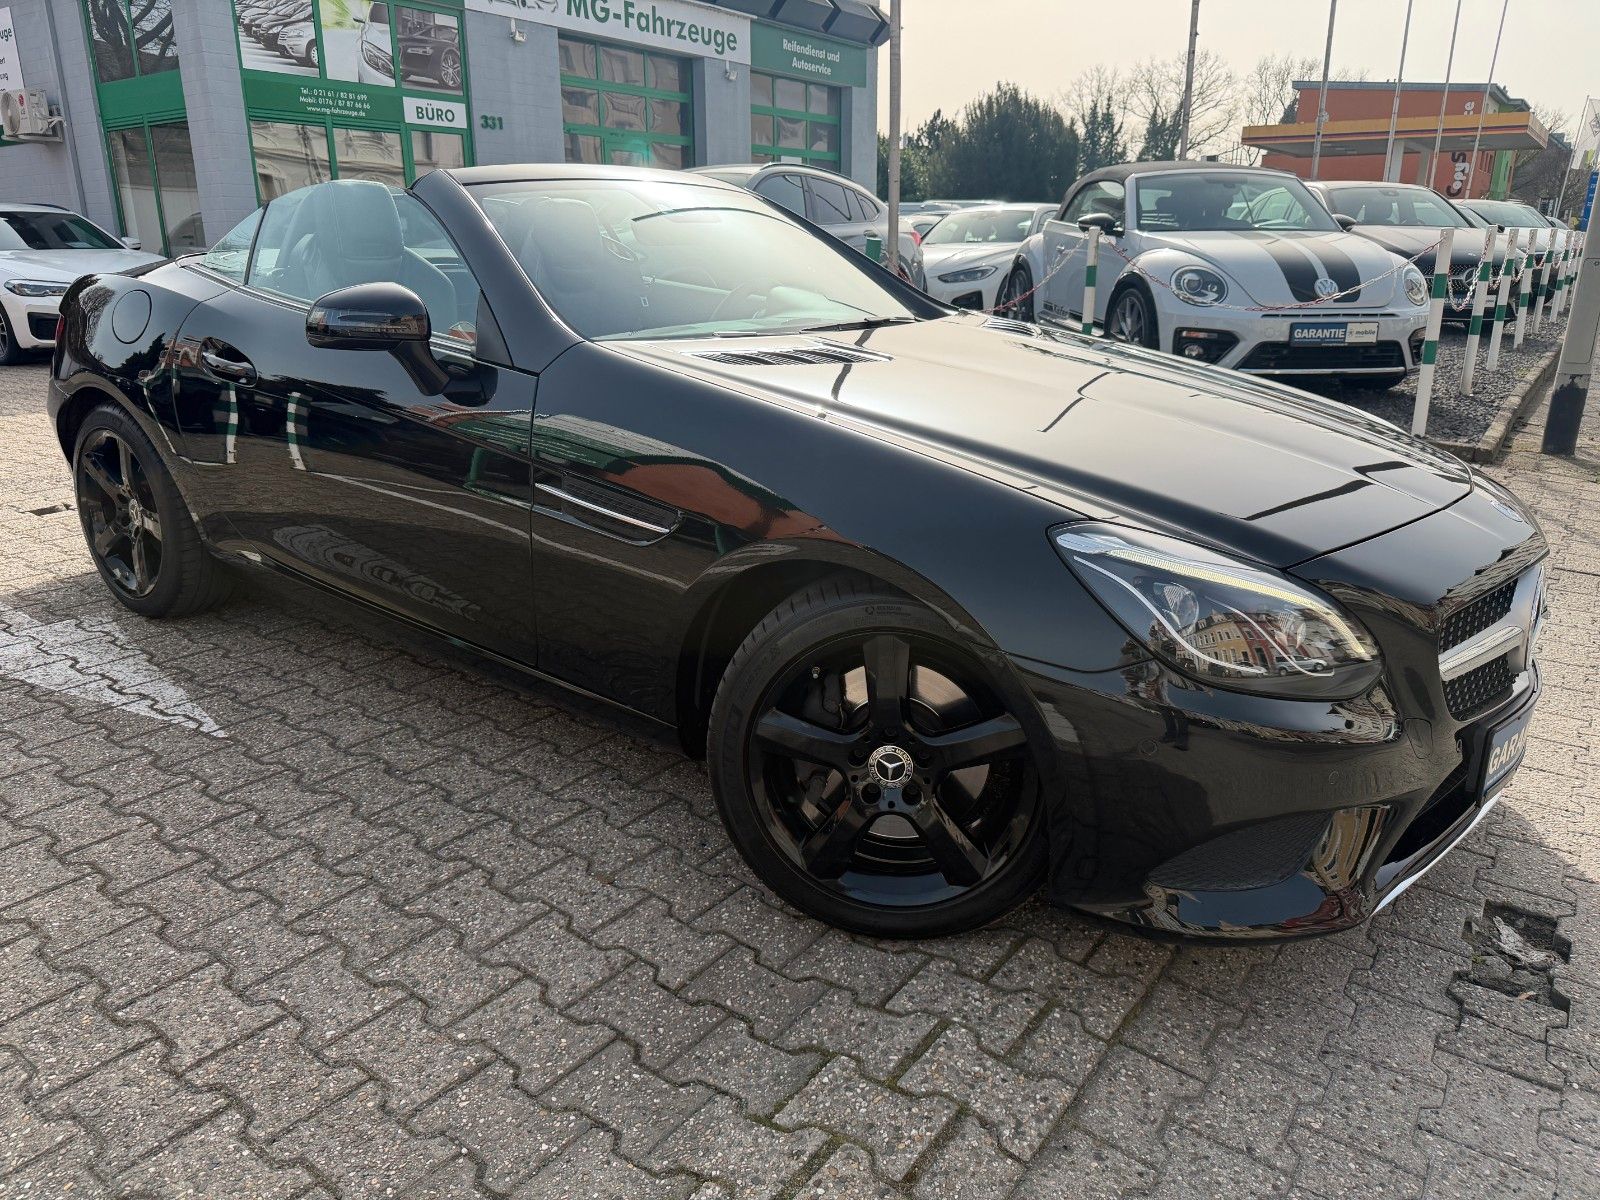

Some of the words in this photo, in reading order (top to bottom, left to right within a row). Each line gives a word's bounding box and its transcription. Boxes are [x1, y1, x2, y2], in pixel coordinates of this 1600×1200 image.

[566, 0, 737, 55] MG-Fahrzeuge
[782, 38, 826, 59] Reifendienst
[826, 50, 840, 62] und
[792, 56, 832, 75] Autoservice
[300, 87, 313, 95] Tel.:
[313, 88, 318, 96] 0
[340, 91, 347, 99] 82
[348, 92, 355, 100] 81
[415, 102, 455, 122] BÜRO
[480, 114, 504, 130] 331
[1294, 328, 1346, 338] GARANTIE
